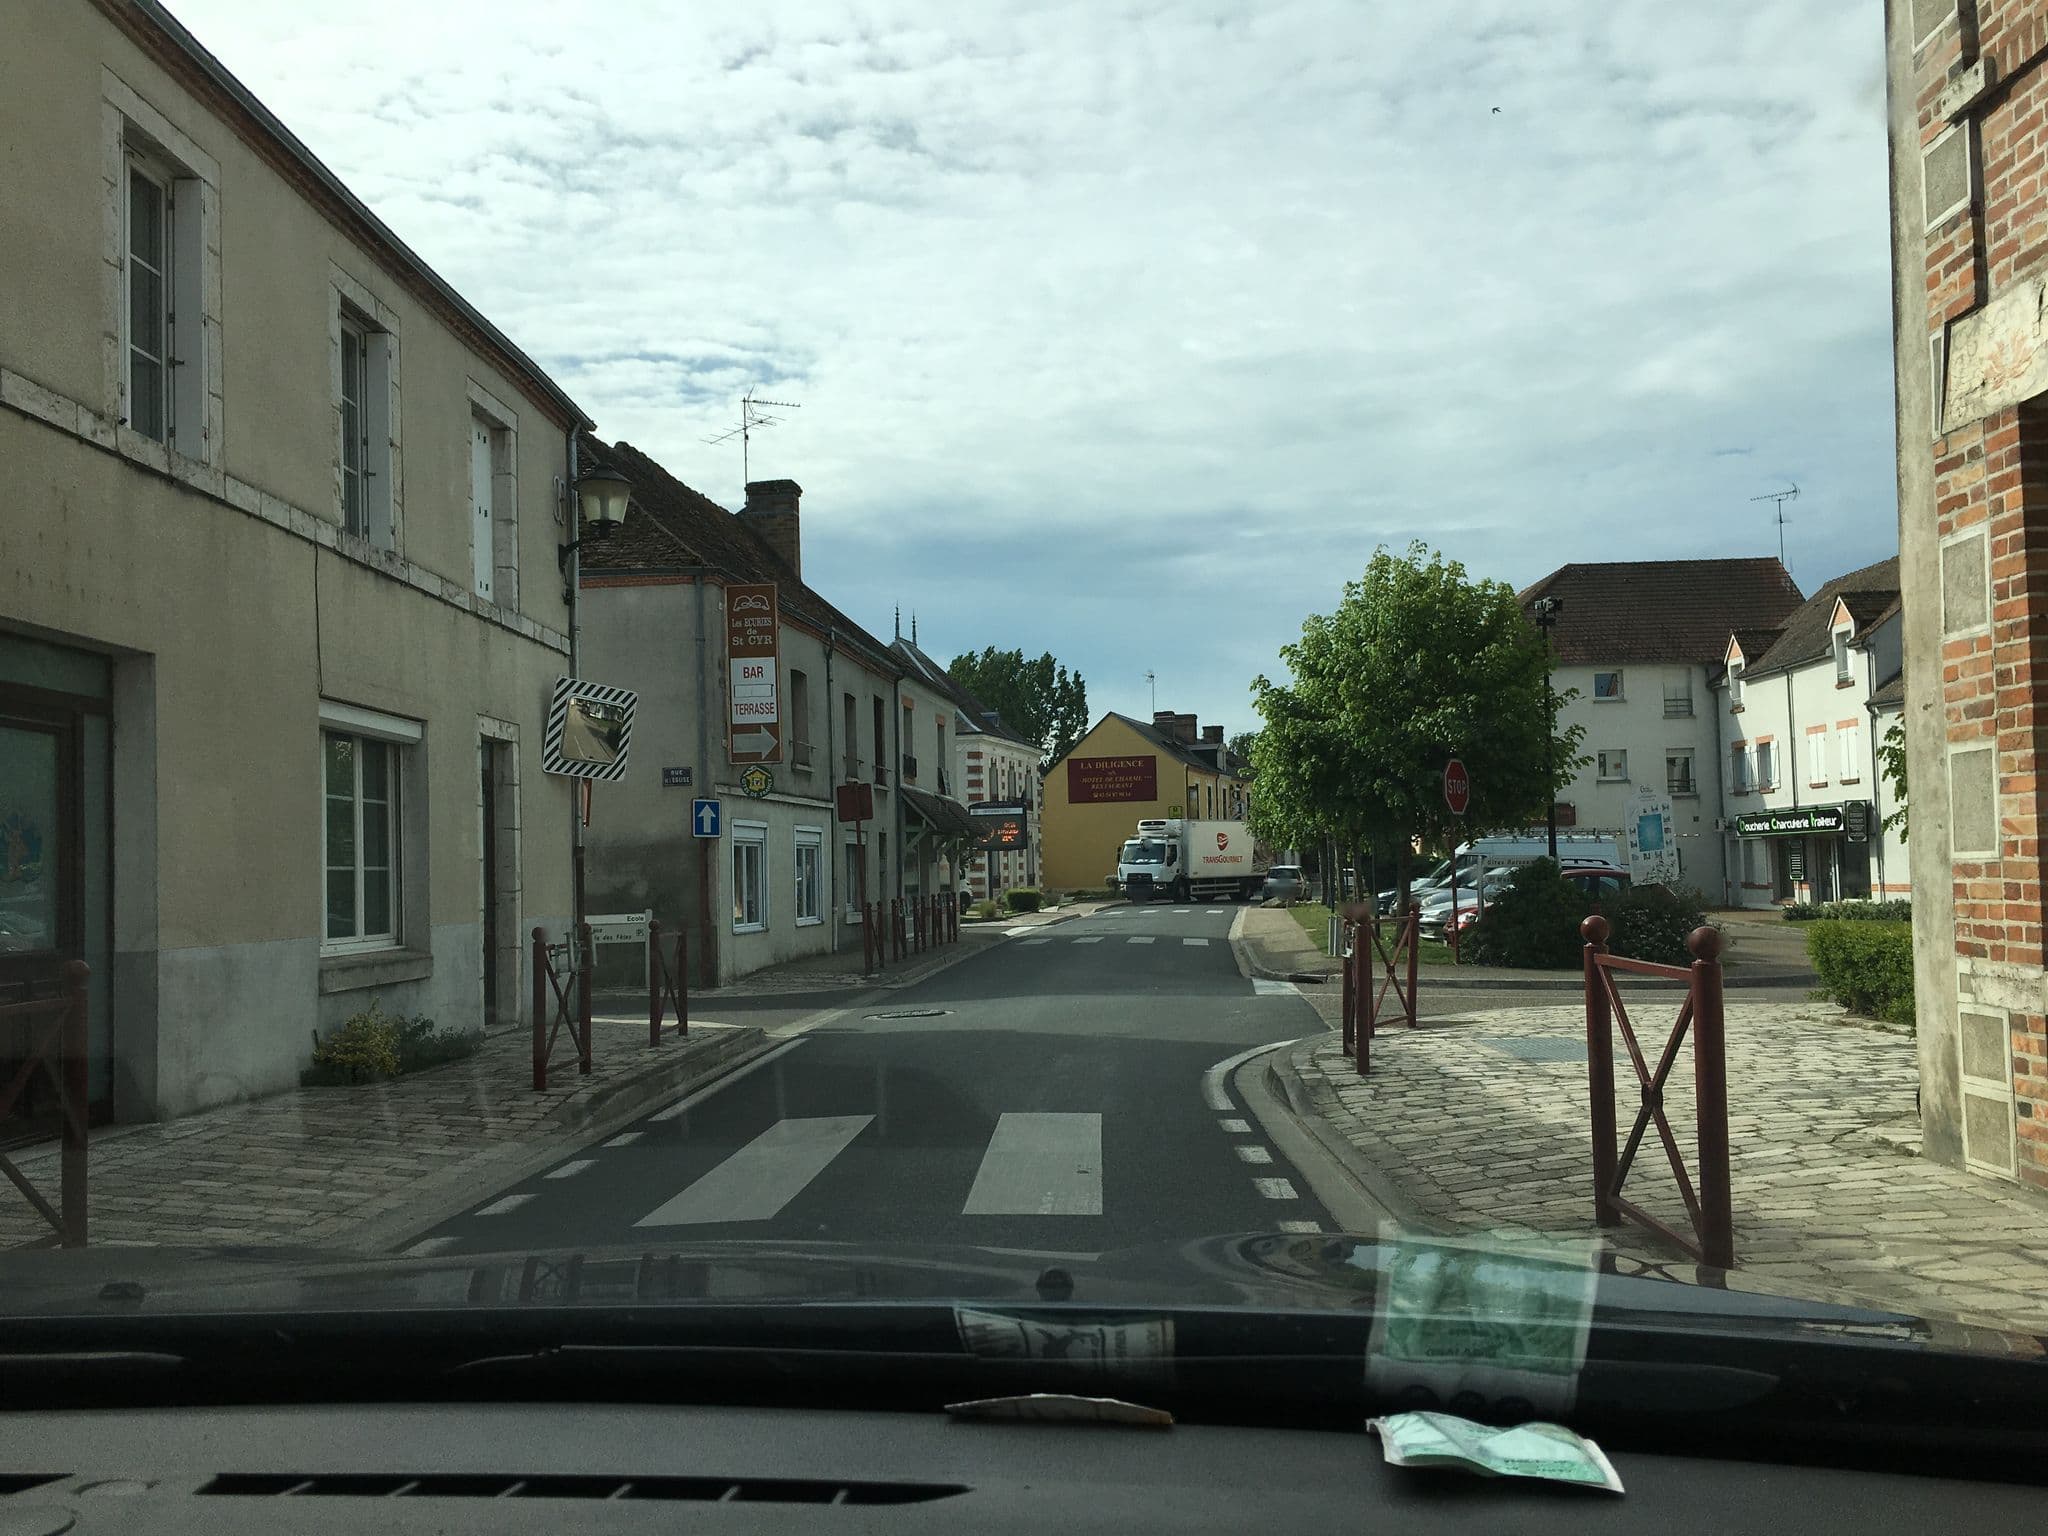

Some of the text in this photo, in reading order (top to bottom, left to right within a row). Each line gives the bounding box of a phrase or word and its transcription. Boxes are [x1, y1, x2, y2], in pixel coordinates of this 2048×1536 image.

[732, 635, 772, 646] St CYR
[743, 666, 764, 678] BAR
[734, 702, 775, 715] TERRASSE
[1095, 760, 1144, 769] DILIGENCE
[1448, 779, 1467, 795] STOP
[1771, 817, 1810, 830] Charcuterie
[1202, 855, 1243, 864] TRANSGOURMET
